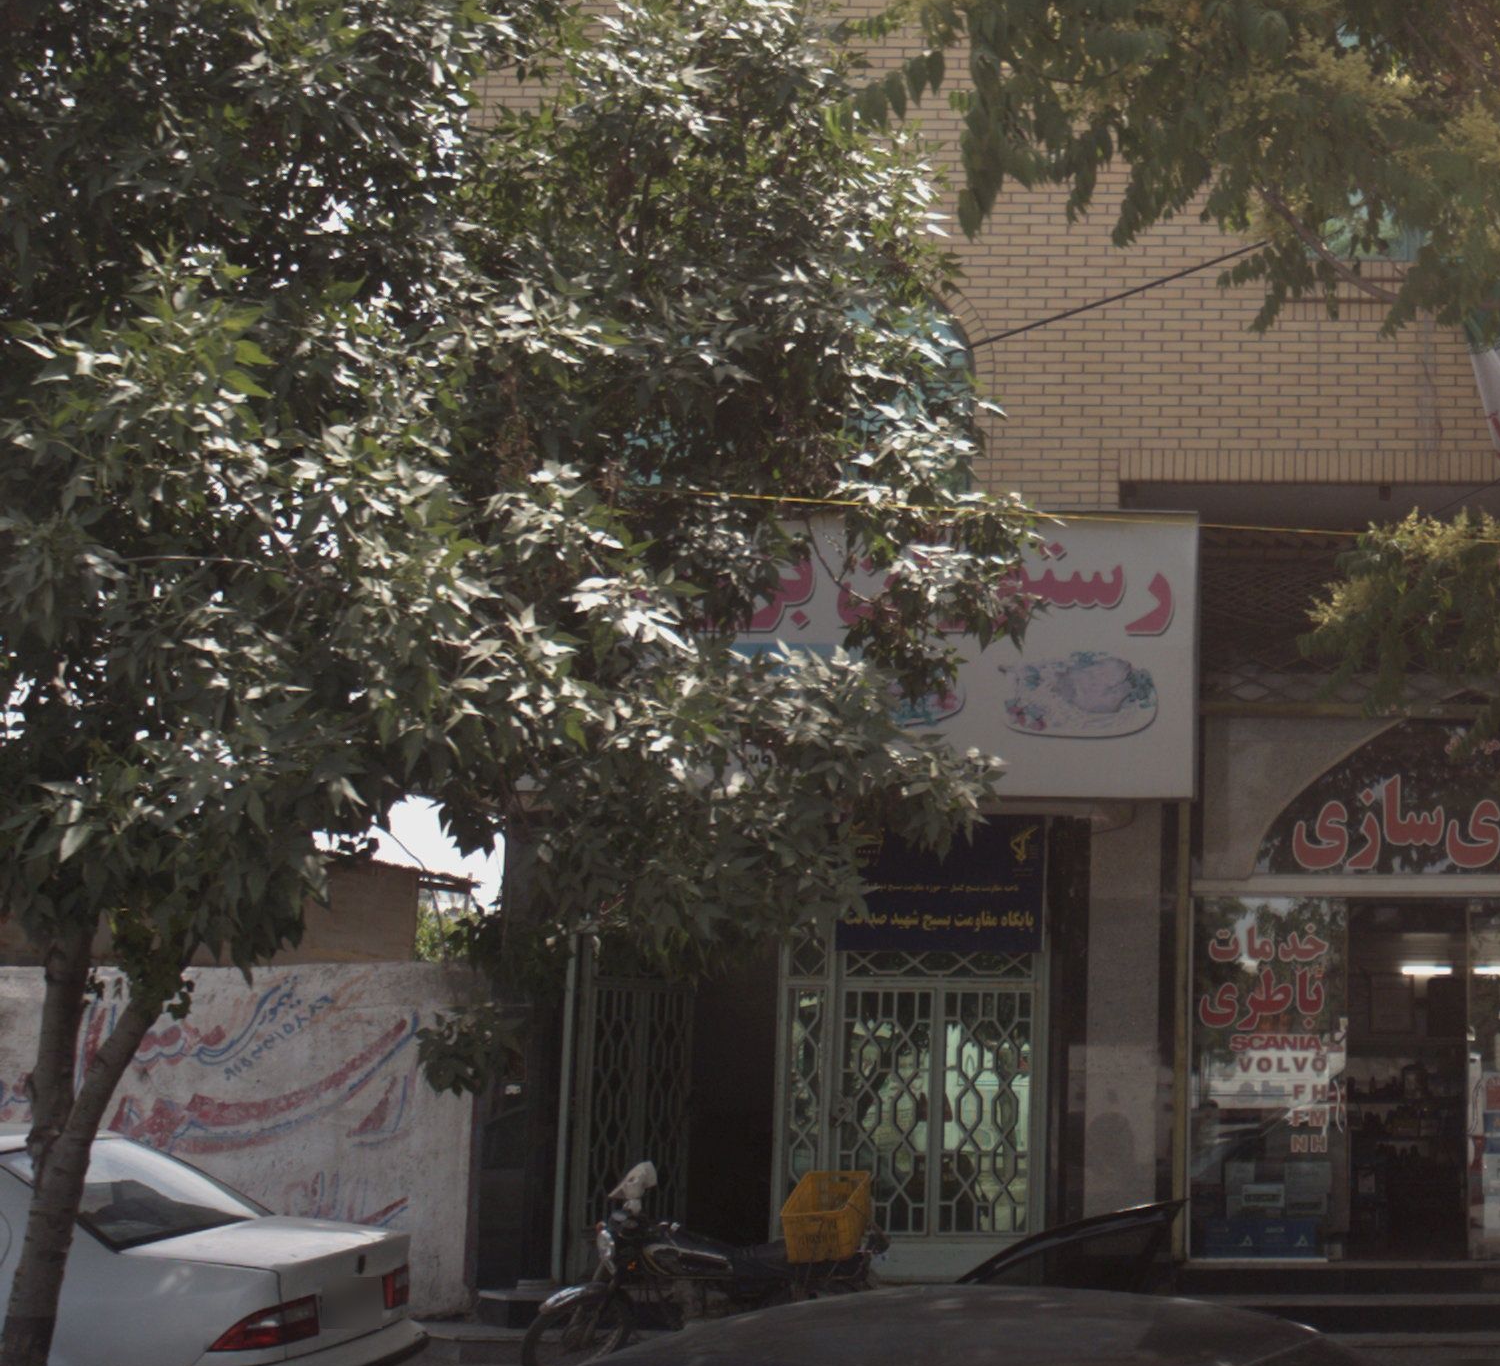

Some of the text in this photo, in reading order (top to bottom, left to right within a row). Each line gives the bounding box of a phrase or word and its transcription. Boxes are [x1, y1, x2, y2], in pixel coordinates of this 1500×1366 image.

[1292, 773, 1445, 870] سازی
[922, 913, 951, 931] بسیج
[953, 911, 998, 932] مقاومت
[1000, 910, 1035, 933] پایگاه
[1208, 922, 1329, 962] خدمات
[1199, 966, 1325, 1030] باطری
[1230, 1034, 1321, 1051] SCANIA
[1240, 1056, 1327, 1073] VOLVO
[1291, 1108, 1328, 1127] FM
[1290, 1133, 1328, 1153] NH
